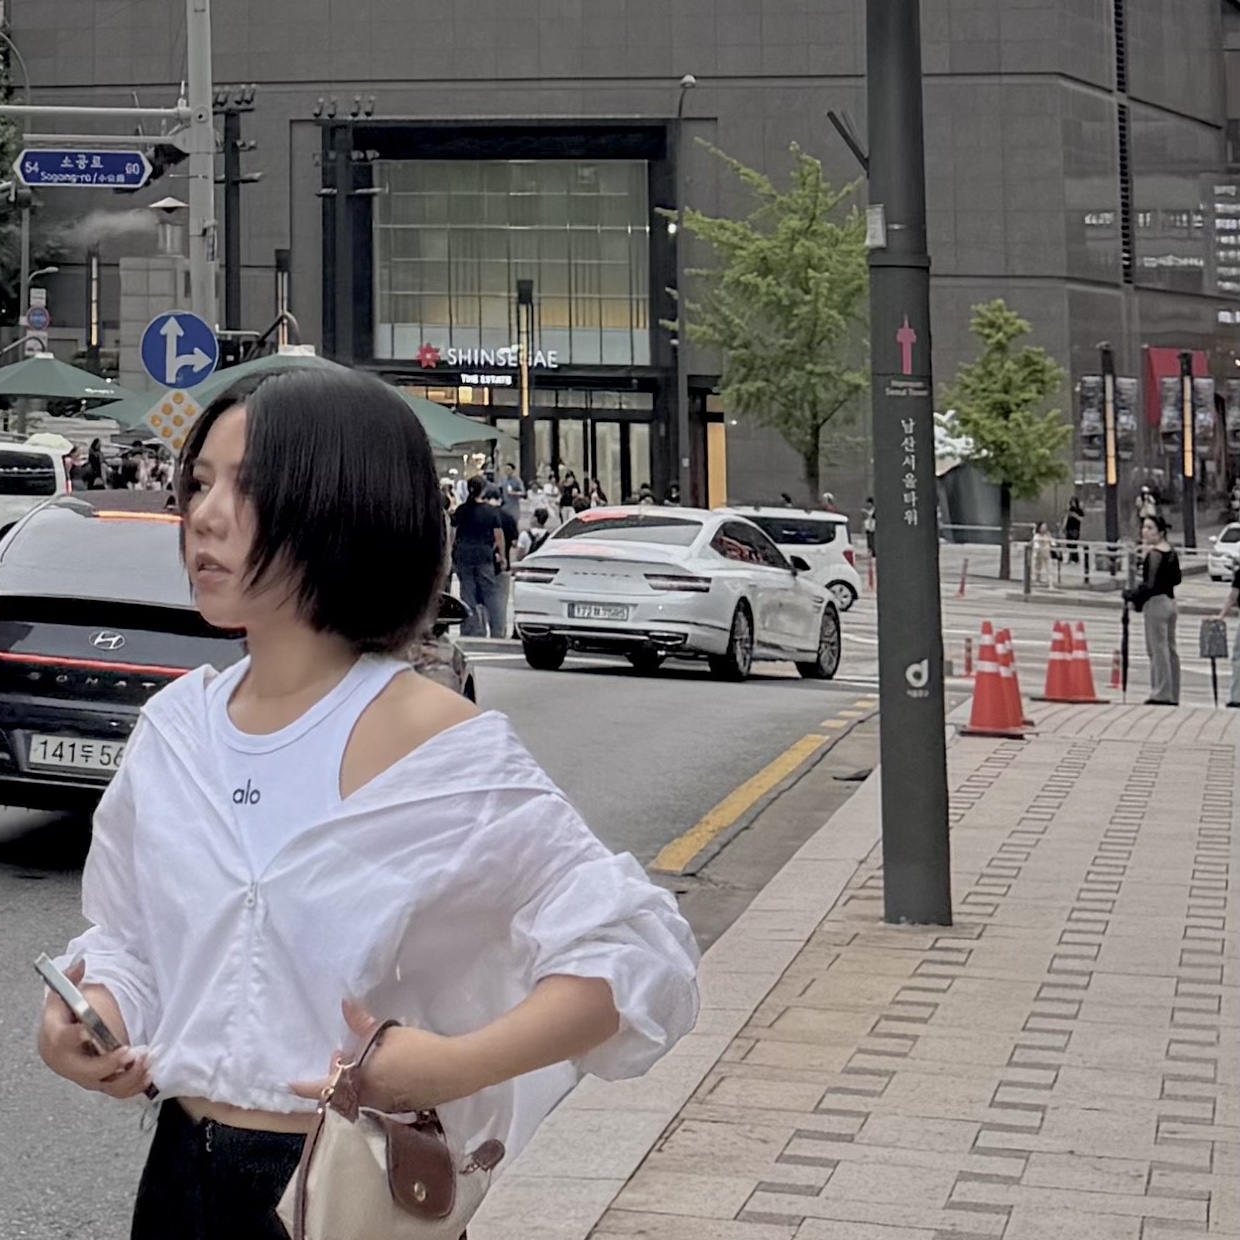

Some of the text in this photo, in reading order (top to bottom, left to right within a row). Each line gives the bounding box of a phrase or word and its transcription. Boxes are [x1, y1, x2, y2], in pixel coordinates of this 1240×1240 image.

[25, 155, 140, 174] 54 소공로 60
[900, 418, 918, 526] 남산서울타워
[232, 779, 261, 805] alo
